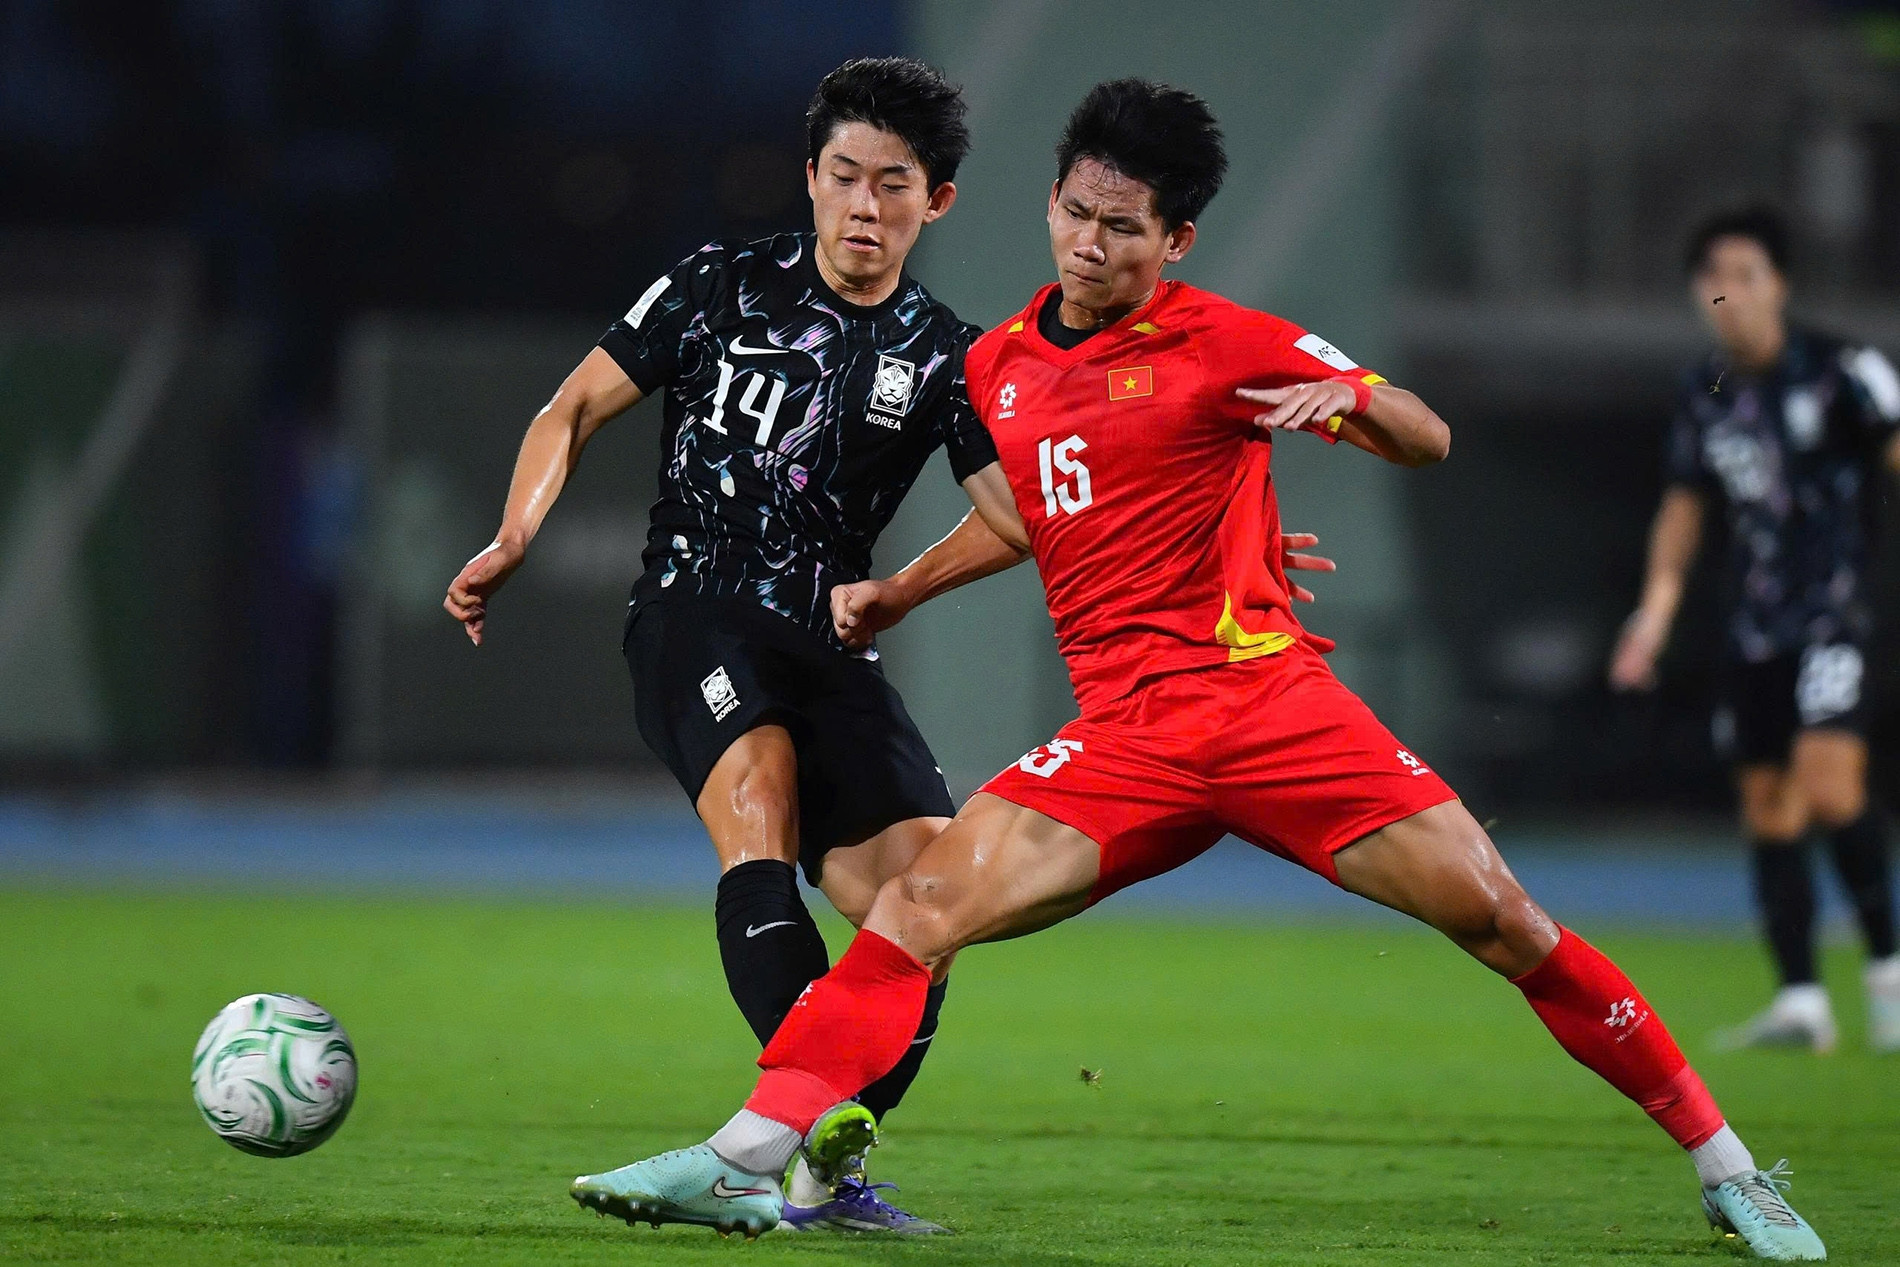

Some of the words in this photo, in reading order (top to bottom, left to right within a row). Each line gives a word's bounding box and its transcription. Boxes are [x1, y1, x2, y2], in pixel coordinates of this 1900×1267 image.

[702, 359, 786, 447] 14
[865, 412, 902, 431] KOREA
[1038, 434, 1093, 519] 15
[715, 698, 741, 723] KOREA
[1014, 738, 1084, 779] 5
